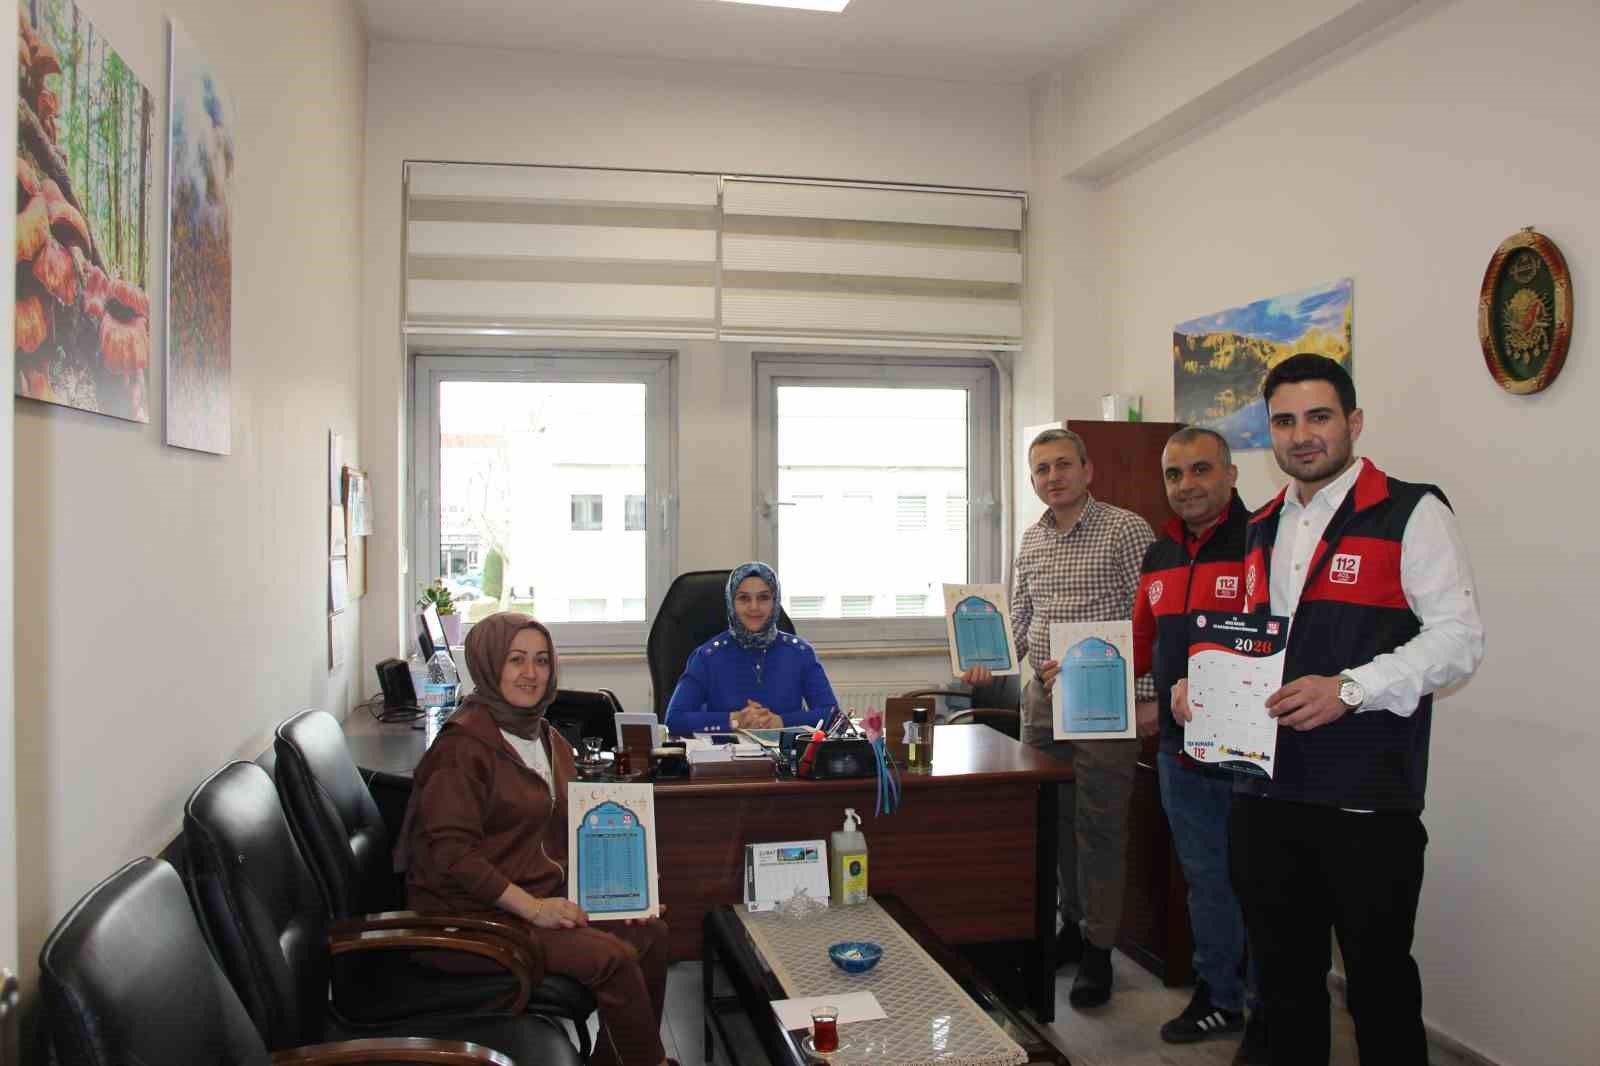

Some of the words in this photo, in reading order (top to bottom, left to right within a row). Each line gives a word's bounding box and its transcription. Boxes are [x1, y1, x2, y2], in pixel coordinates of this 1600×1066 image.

[1336, 558, 1355, 571] 112
[1219, 578, 1235, 588] 112
[1234, 638, 1272, 654] 2026
[1193, 747, 1206, 760] 112
